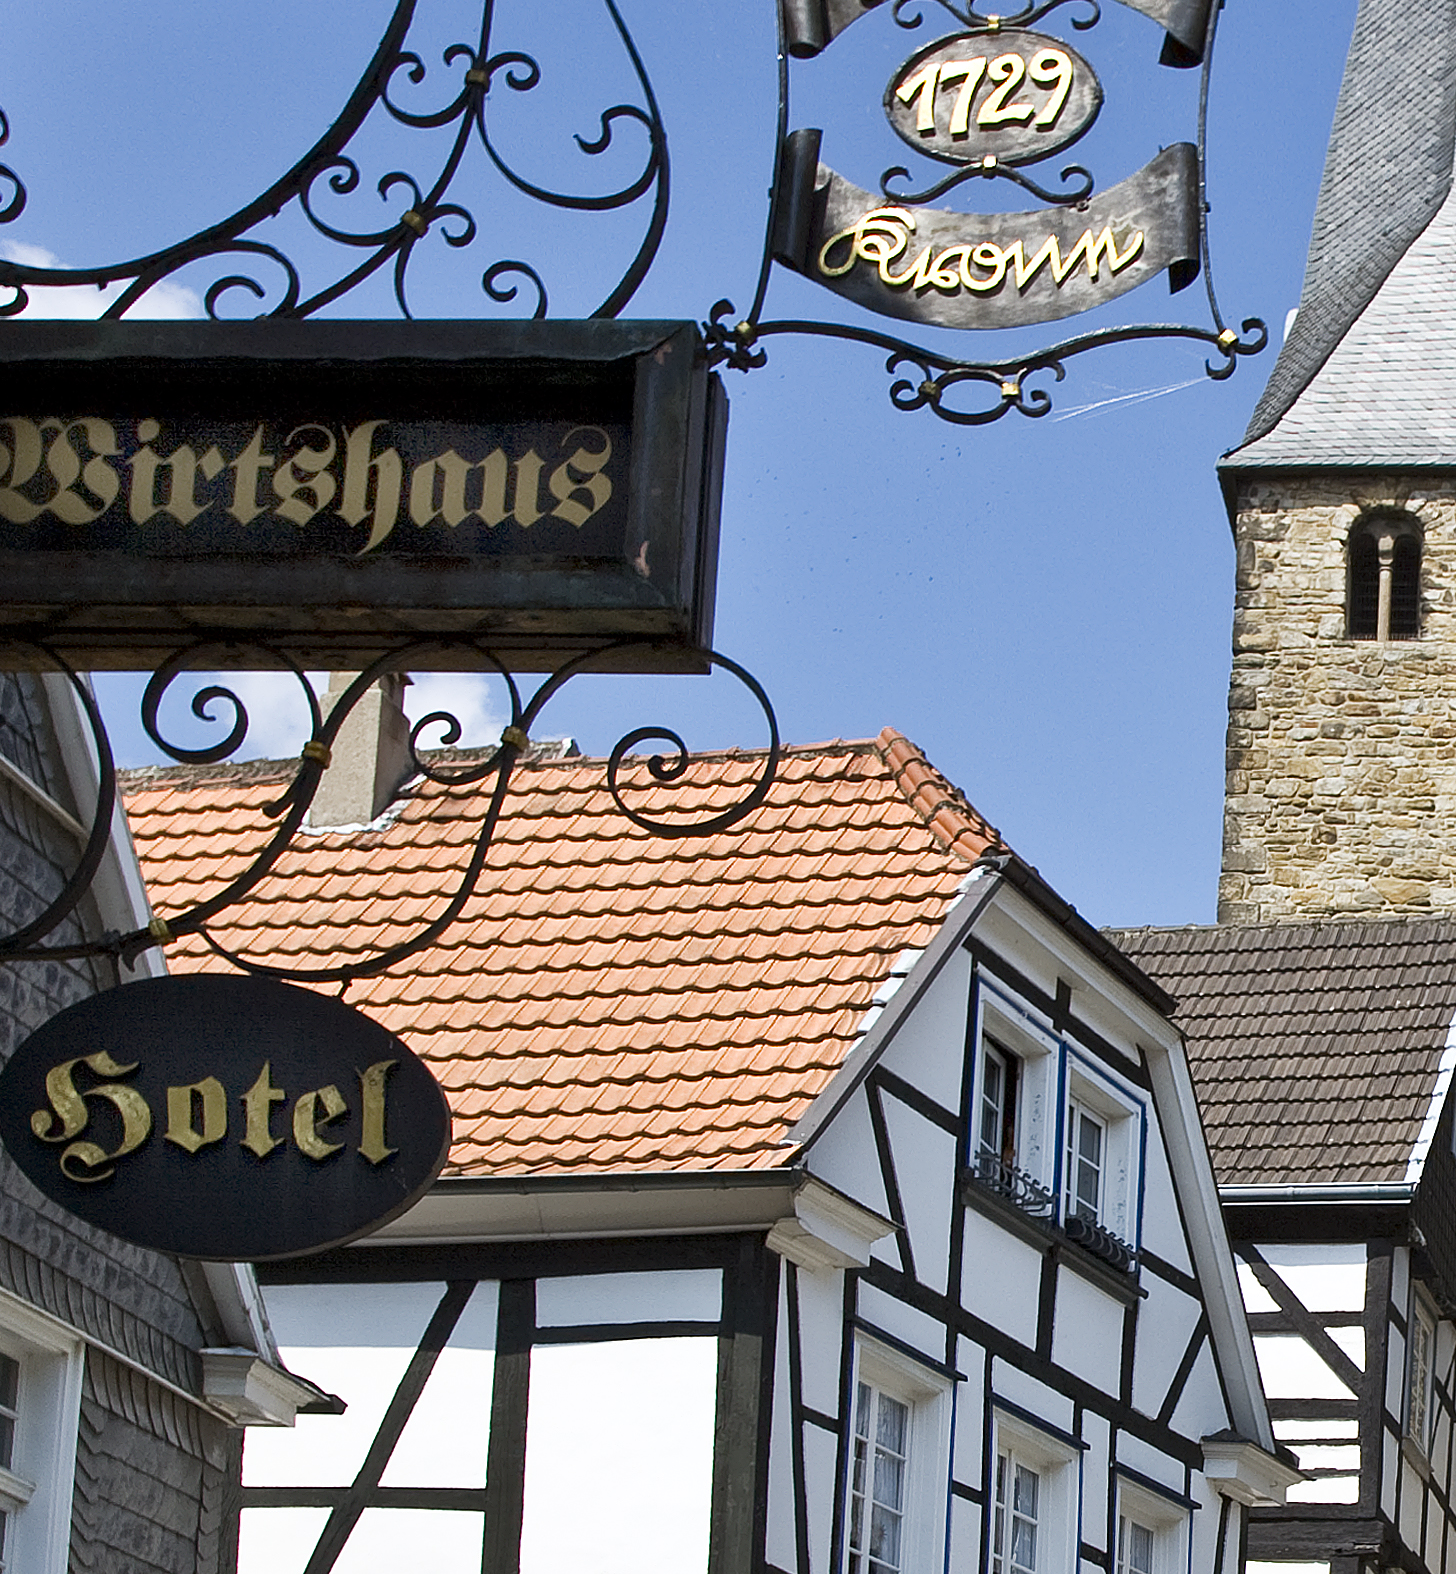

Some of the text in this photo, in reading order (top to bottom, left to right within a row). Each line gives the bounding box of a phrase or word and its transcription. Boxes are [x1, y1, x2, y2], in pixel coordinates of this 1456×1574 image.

[897, 47, 1075, 135] 1729
[0, 416, 613, 556] Wirtshaus
[30, 1050, 399, 1183] Hotel
